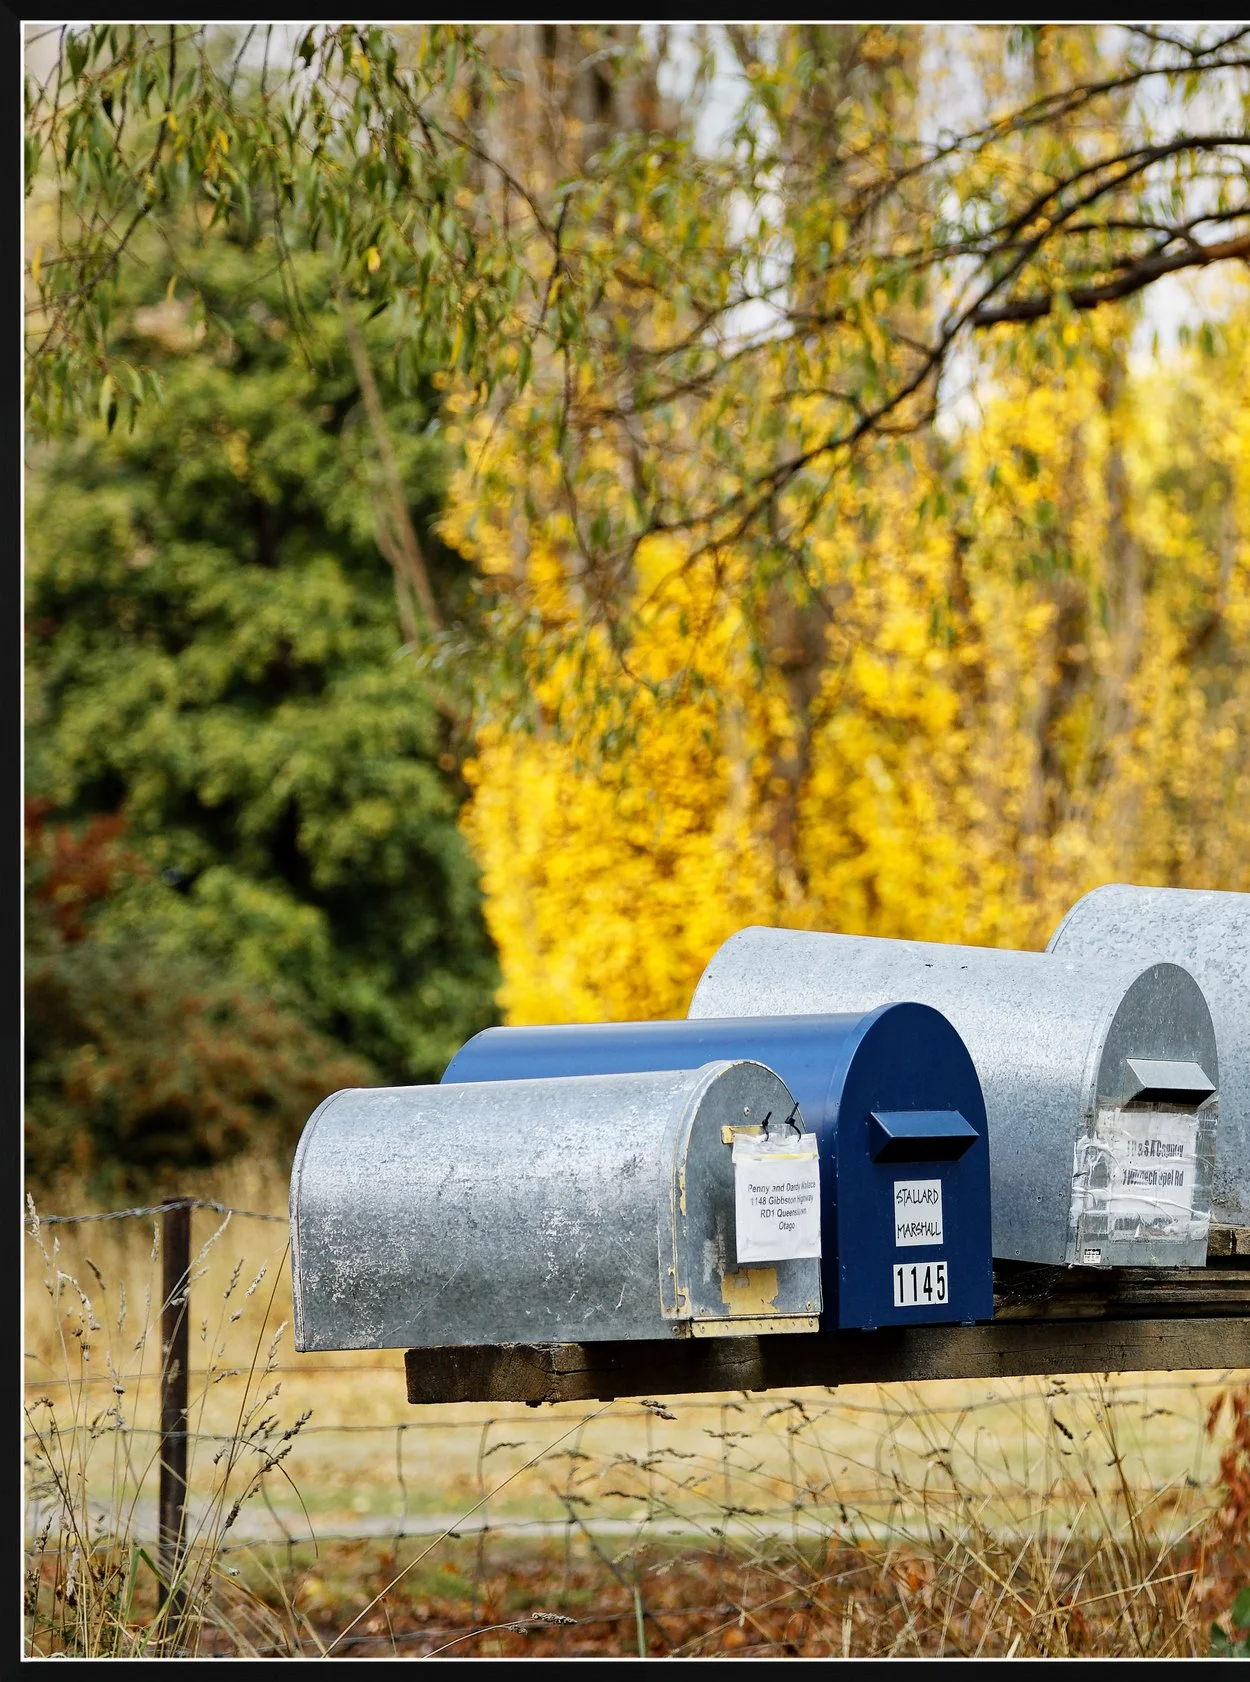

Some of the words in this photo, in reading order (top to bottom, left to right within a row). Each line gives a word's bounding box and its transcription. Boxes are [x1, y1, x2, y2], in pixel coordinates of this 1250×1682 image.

[1174, 1170, 1184, 1187] Rd
[747, 1183, 769, 1195] Penny
[771, 1183, 785, 1192] and
[751, 1196, 767, 1206] 1148
[768, 1196, 797, 1205] Gibbston
[896, 1188, 939, 1207] STALLARD
[760, 1208, 775, 1218] RD1
[778, 1221, 796, 1232] Otago
[897, 1221, 941, 1239] MARSHALL
[897, 1264, 946, 1304] 1145
